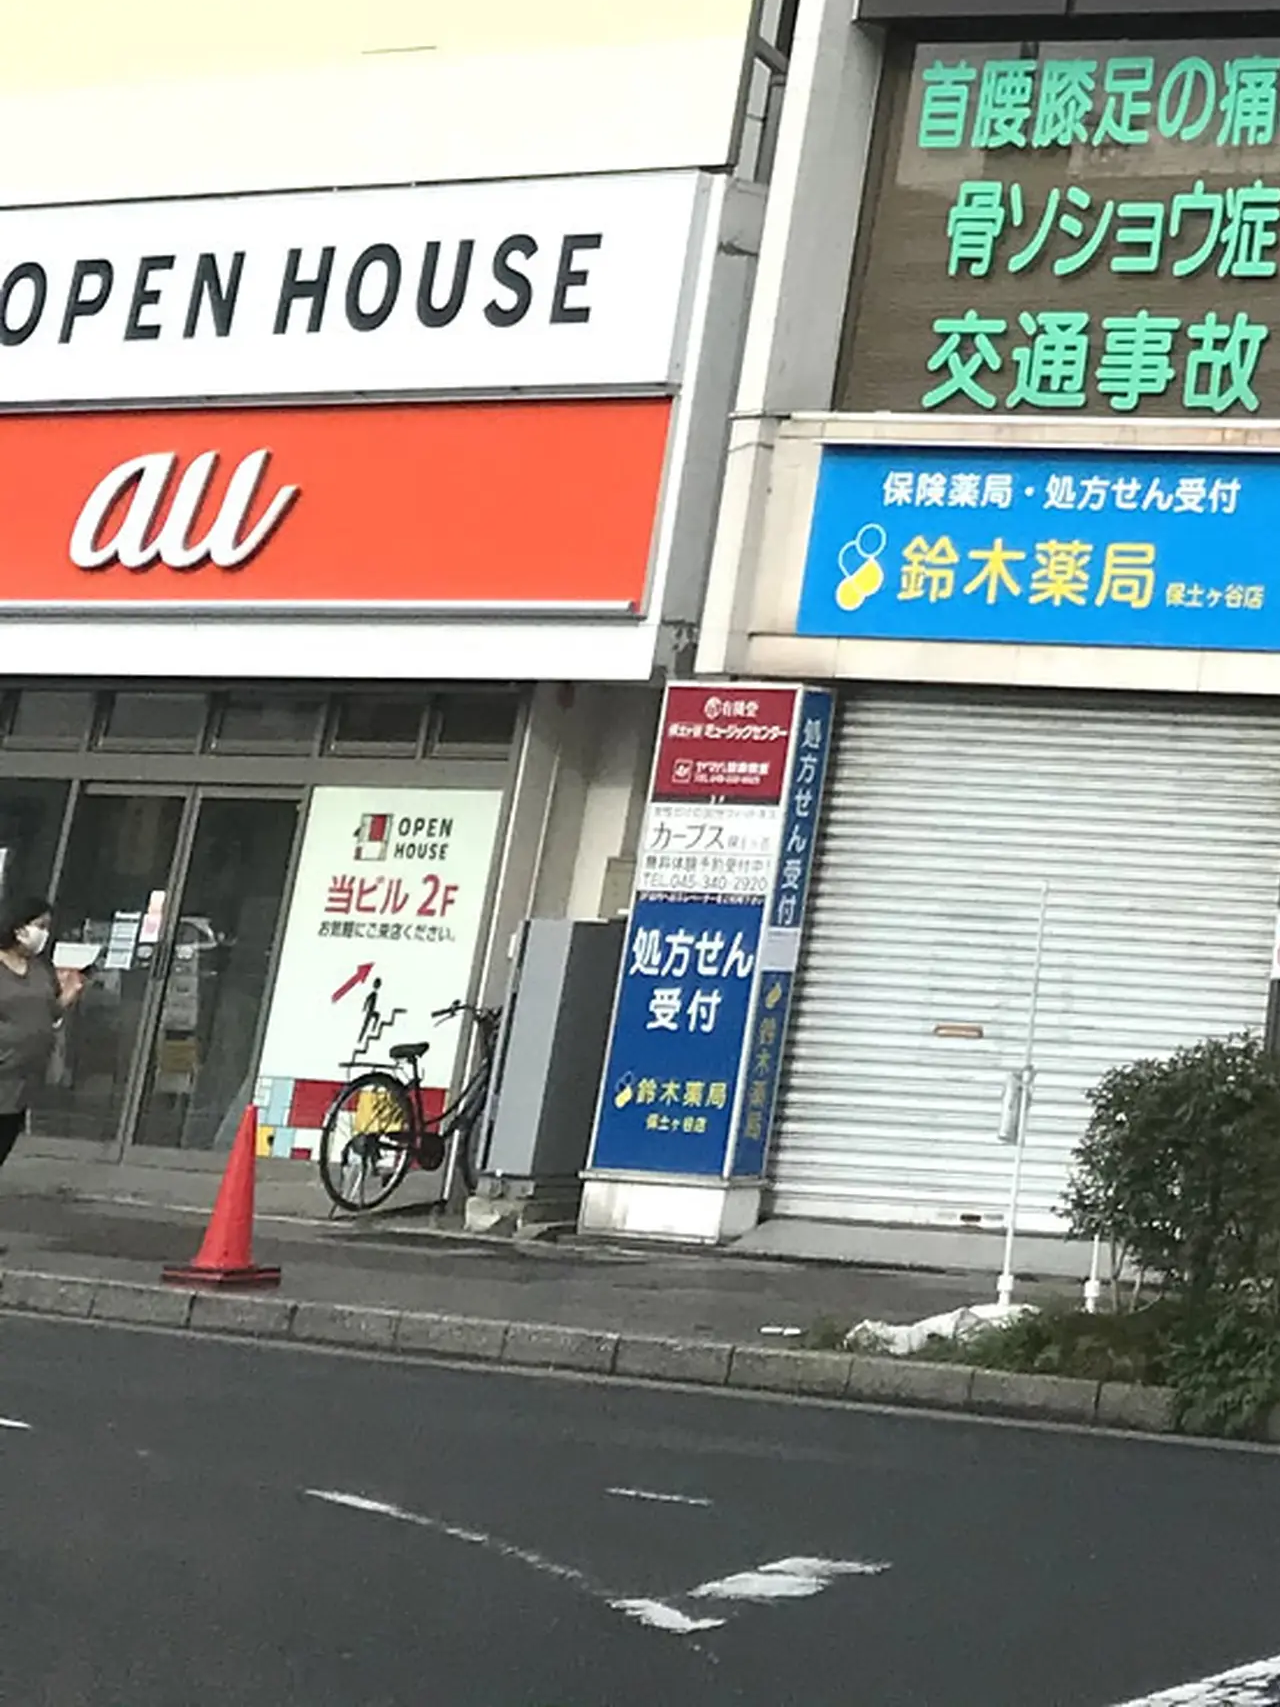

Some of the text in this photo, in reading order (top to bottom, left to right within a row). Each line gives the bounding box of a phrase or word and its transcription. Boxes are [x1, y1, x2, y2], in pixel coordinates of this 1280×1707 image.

[0, 232, 605, 348] OPEN HOUSE
[920, 308, 1270, 413] 交通事故
[68, 448, 301, 571] au
[896, 533, 1157, 608] 鈴木薬局
[393, 842, 450, 861] HOUSE
[397, 816, 454, 838] OPEN
[628, 926, 756, 979] 処方せん
[645, 987, 723, 1033] 受付
